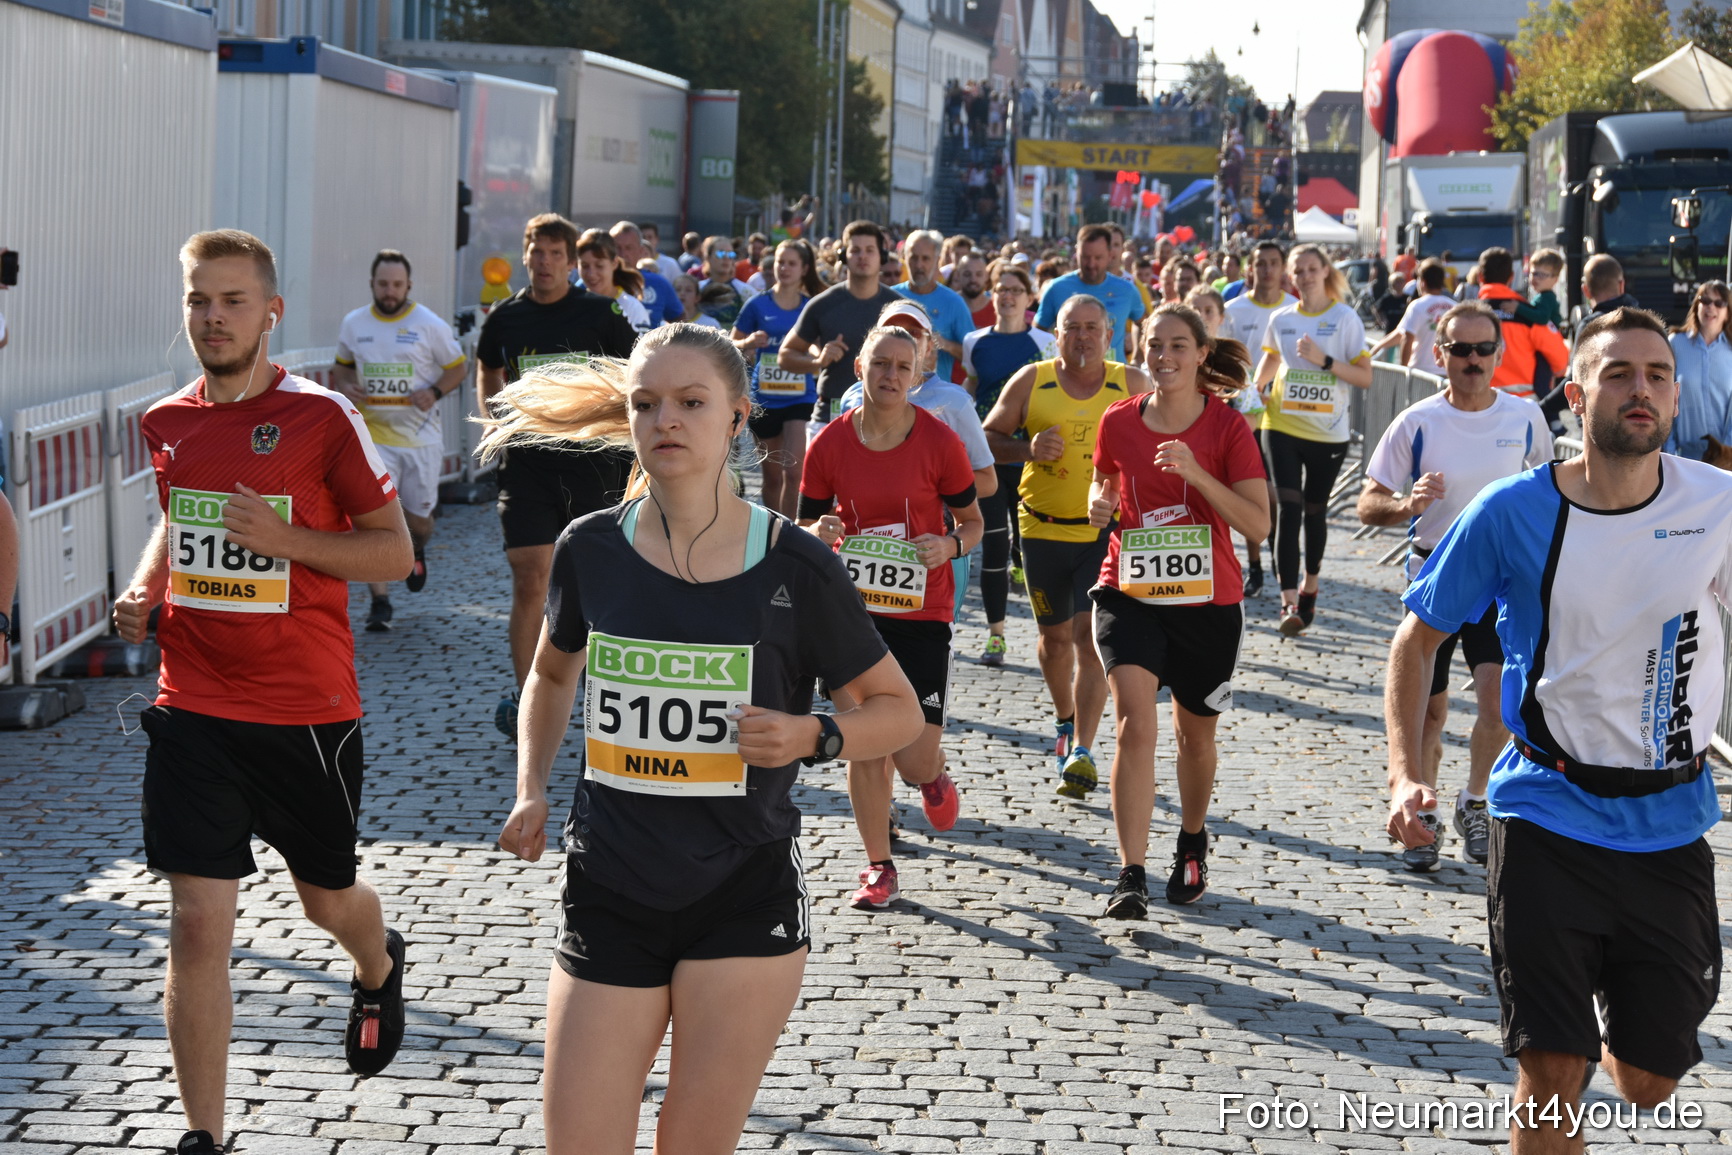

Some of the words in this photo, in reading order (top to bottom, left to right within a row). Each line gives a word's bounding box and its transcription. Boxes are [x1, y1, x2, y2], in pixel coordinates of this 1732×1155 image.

[1083, 147, 1151, 166] START
[367, 379, 409, 394] 5240
[1289, 372, 1334, 383] BOCK
[1288, 385, 1330, 402] 5090
[1154, 509, 1175, 522] DEHN
[846, 538, 921, 563] BOCK
[1127, 529, 1204, 549] BOCK
[178, 531, 274, 573] 5188
[845, 558, 915, 591] 5182
[1130, 553, 1203, 579] 5180
[188, 579, 257, 599] TOBIAS
[1148, 585, 1185, 596] JANA
[770, 599, 793, 608] Reebok
[595, 640, 737, 686] BOCK
[1645, 648, 1657, 686] WASTE
[1666, 609, 1700, 766] HUBER
[598, 688, 728, 744] 5105
[1641, 688, 1653, 723] WATER
[1641, 725, 1653, 767] Solutions
[625, 754, 690, 778] NINA
